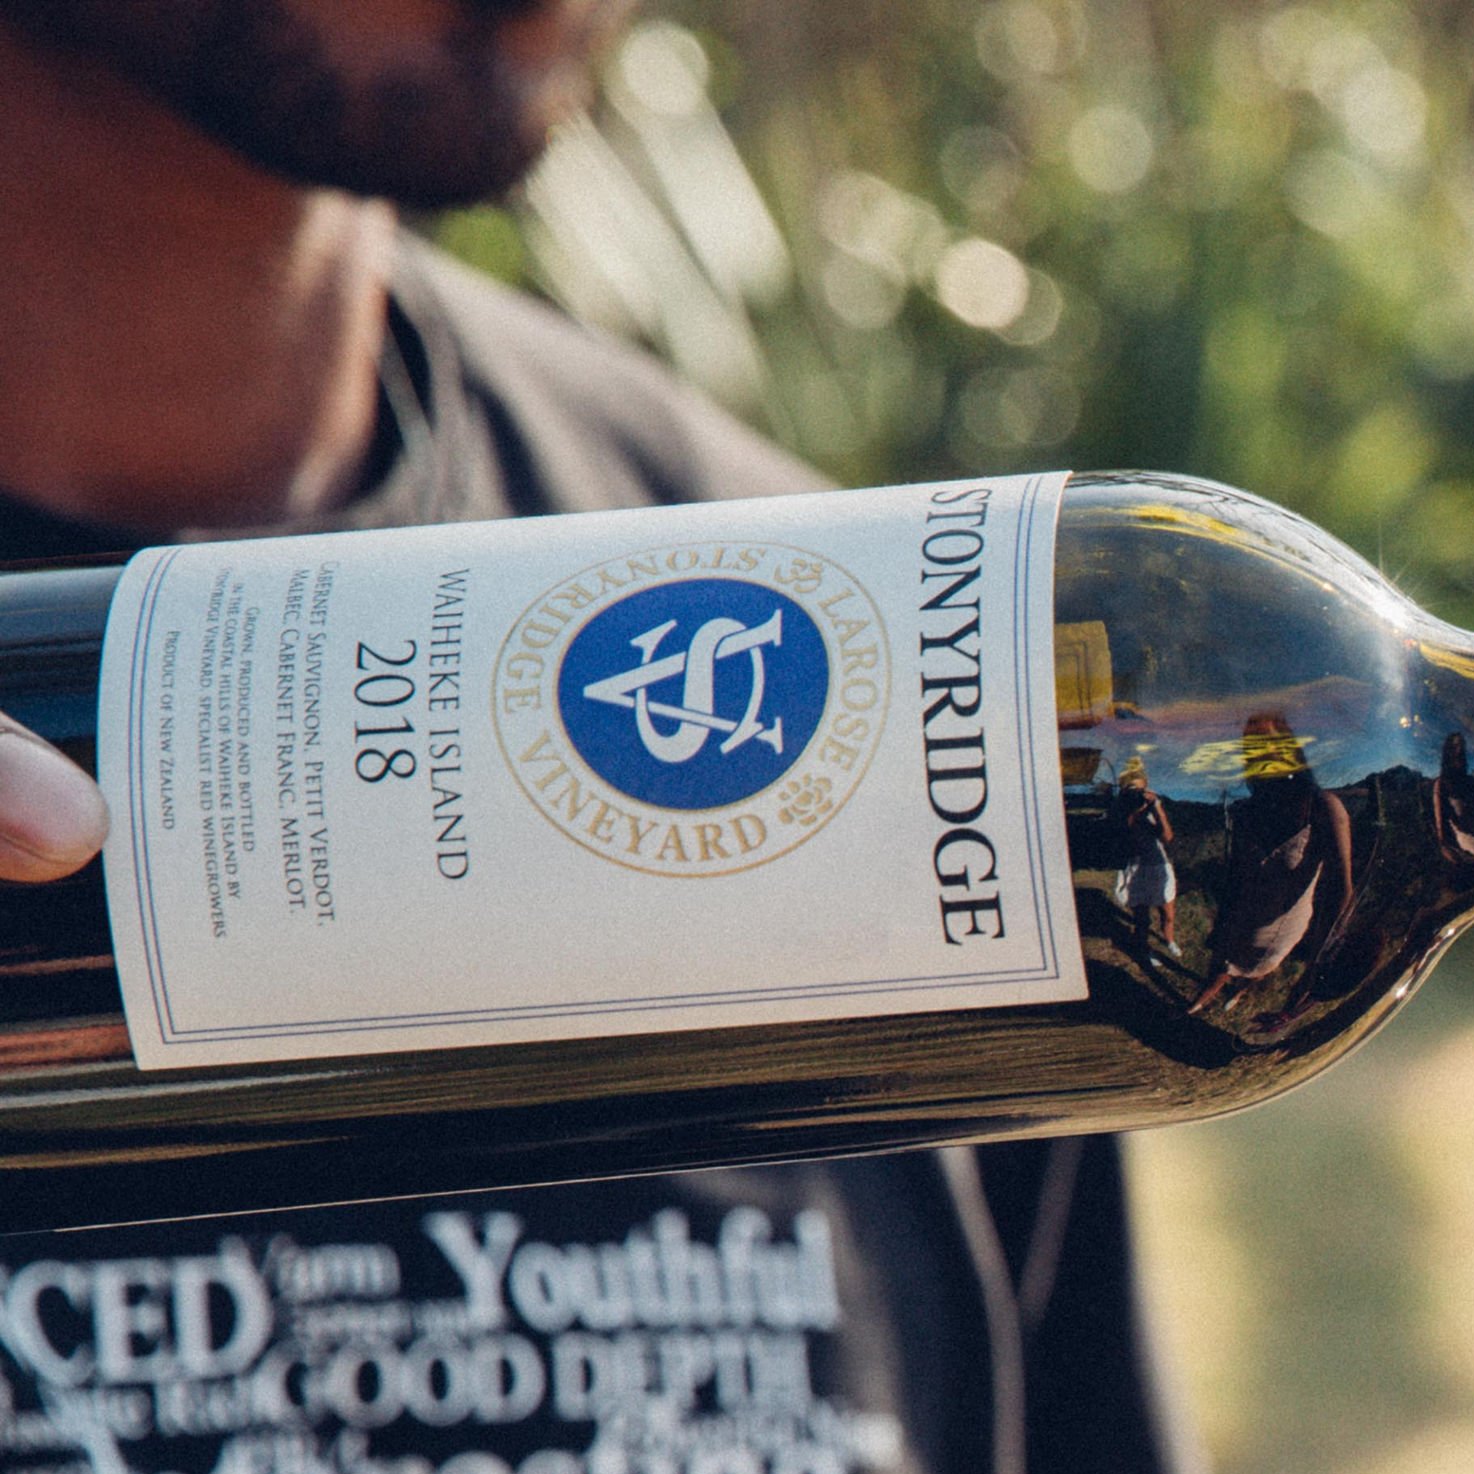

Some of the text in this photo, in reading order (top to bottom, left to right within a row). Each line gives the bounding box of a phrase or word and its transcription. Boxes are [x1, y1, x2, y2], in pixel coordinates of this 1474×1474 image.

[309, 559, 340, 627] CABERNET
[219, 617, 239, 670] COASTAL
[276, 627, 300, 724] CABERNET
[817, 587, 879, 772] LAROSE
[159, 630, 182, 831] PRODUCT OF NEW ZEALAND
[216, 714, 232, 734] OF
[217, 673, 232, 712] HILLS
[236, 660, 253, 738] PRODUCED
[353, 639, 418, 784] 2018
[427, 567, 470, 881] WAIHEKE ISLAND
[502, 547, 768, 864] STONYRIDGE VINEYARD
[919, 487, 1006, 946] STONYRIDGE
[197, 695, 213, 774] SPECIALIST
[235, 741, 250, 776] AND
[198, 780, 214, 812] RED
[217, 737, 234, 811] WAIHEKE
[303, 760, 325, 820] PETIT
[220, 815, 239, 877] ISLAND
[237, 781, 256, 852] BOTTLED
[201, 816, 228, 939] WINEGROWERS
[226, 880, 242, 901] BY
[421, 1207, 840, 1332] Youthful
[0, 1240, 273, 1389] CED
[252, 1331, 547, 1426] GOOD
